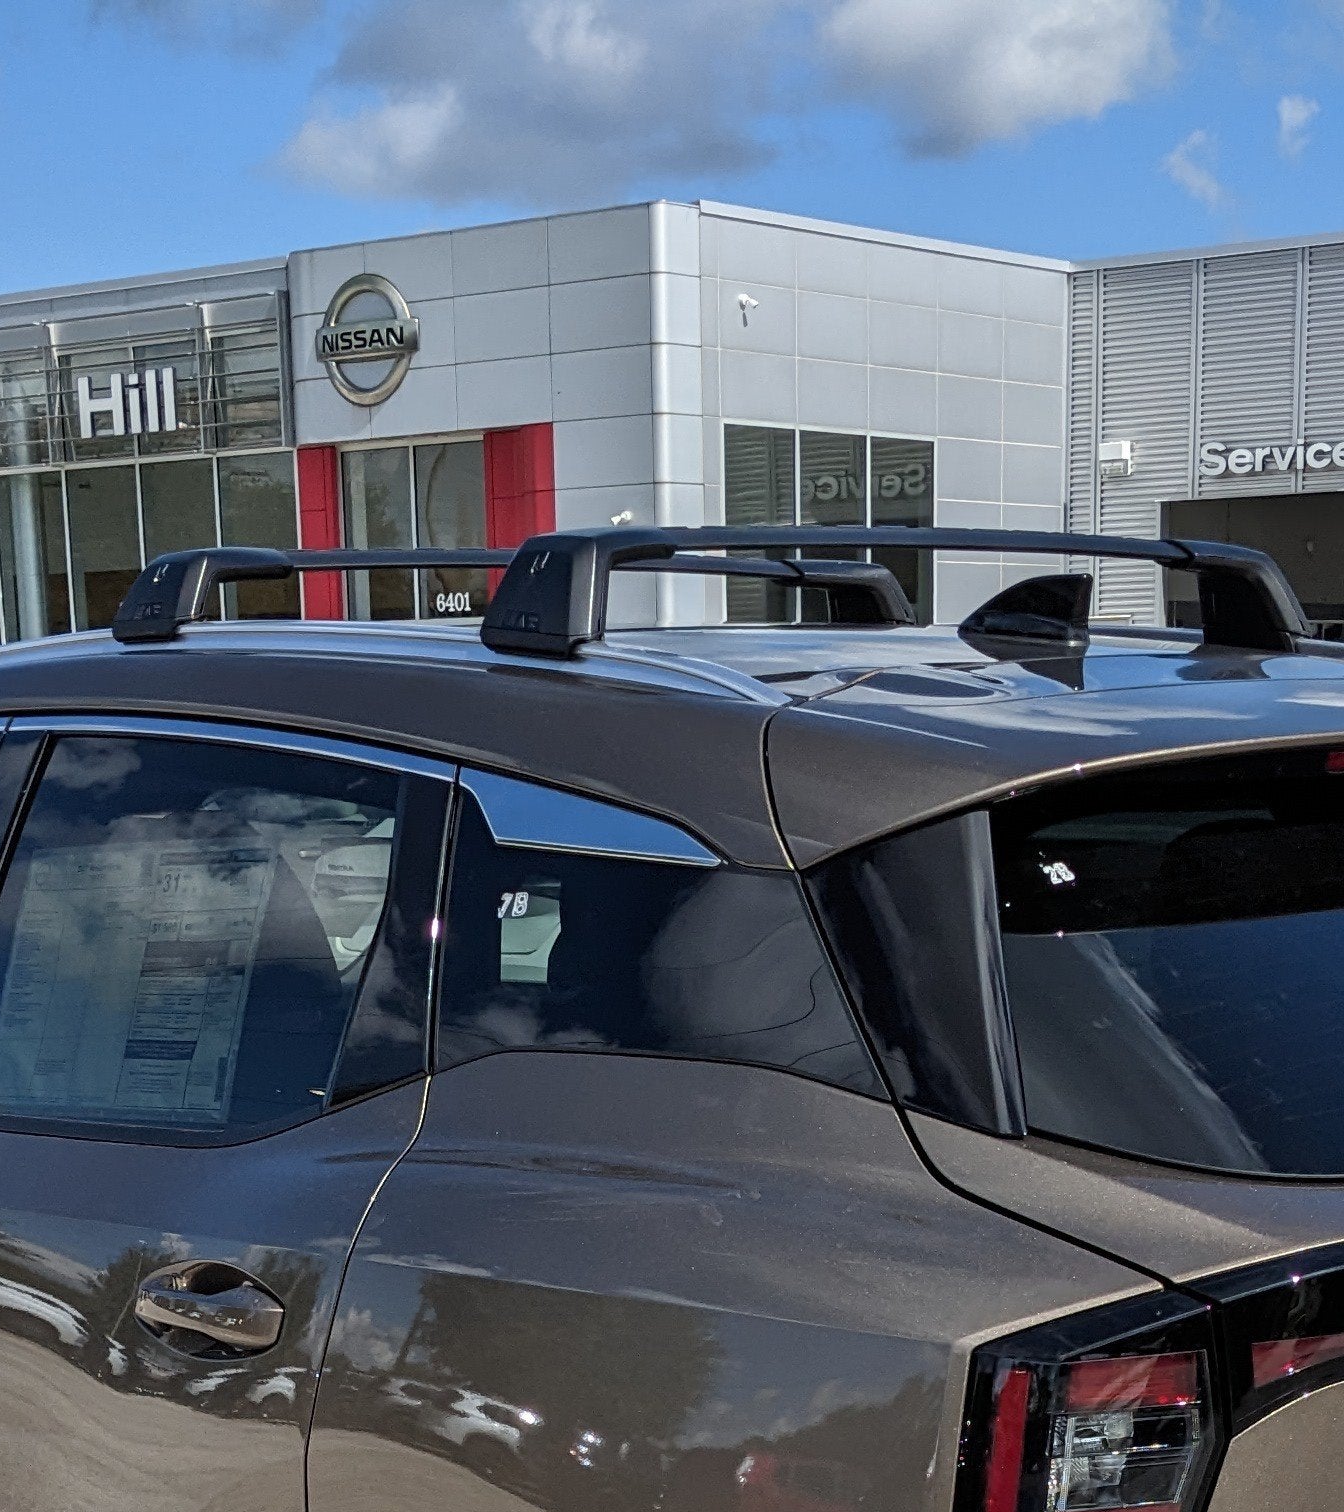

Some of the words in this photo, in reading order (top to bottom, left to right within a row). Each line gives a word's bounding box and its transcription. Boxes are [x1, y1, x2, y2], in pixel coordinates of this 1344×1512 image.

[321, 326, 404, 354] NISSAN
[77, 366, 176, 439] Hill
[435, 591, 472, 613] 6401
